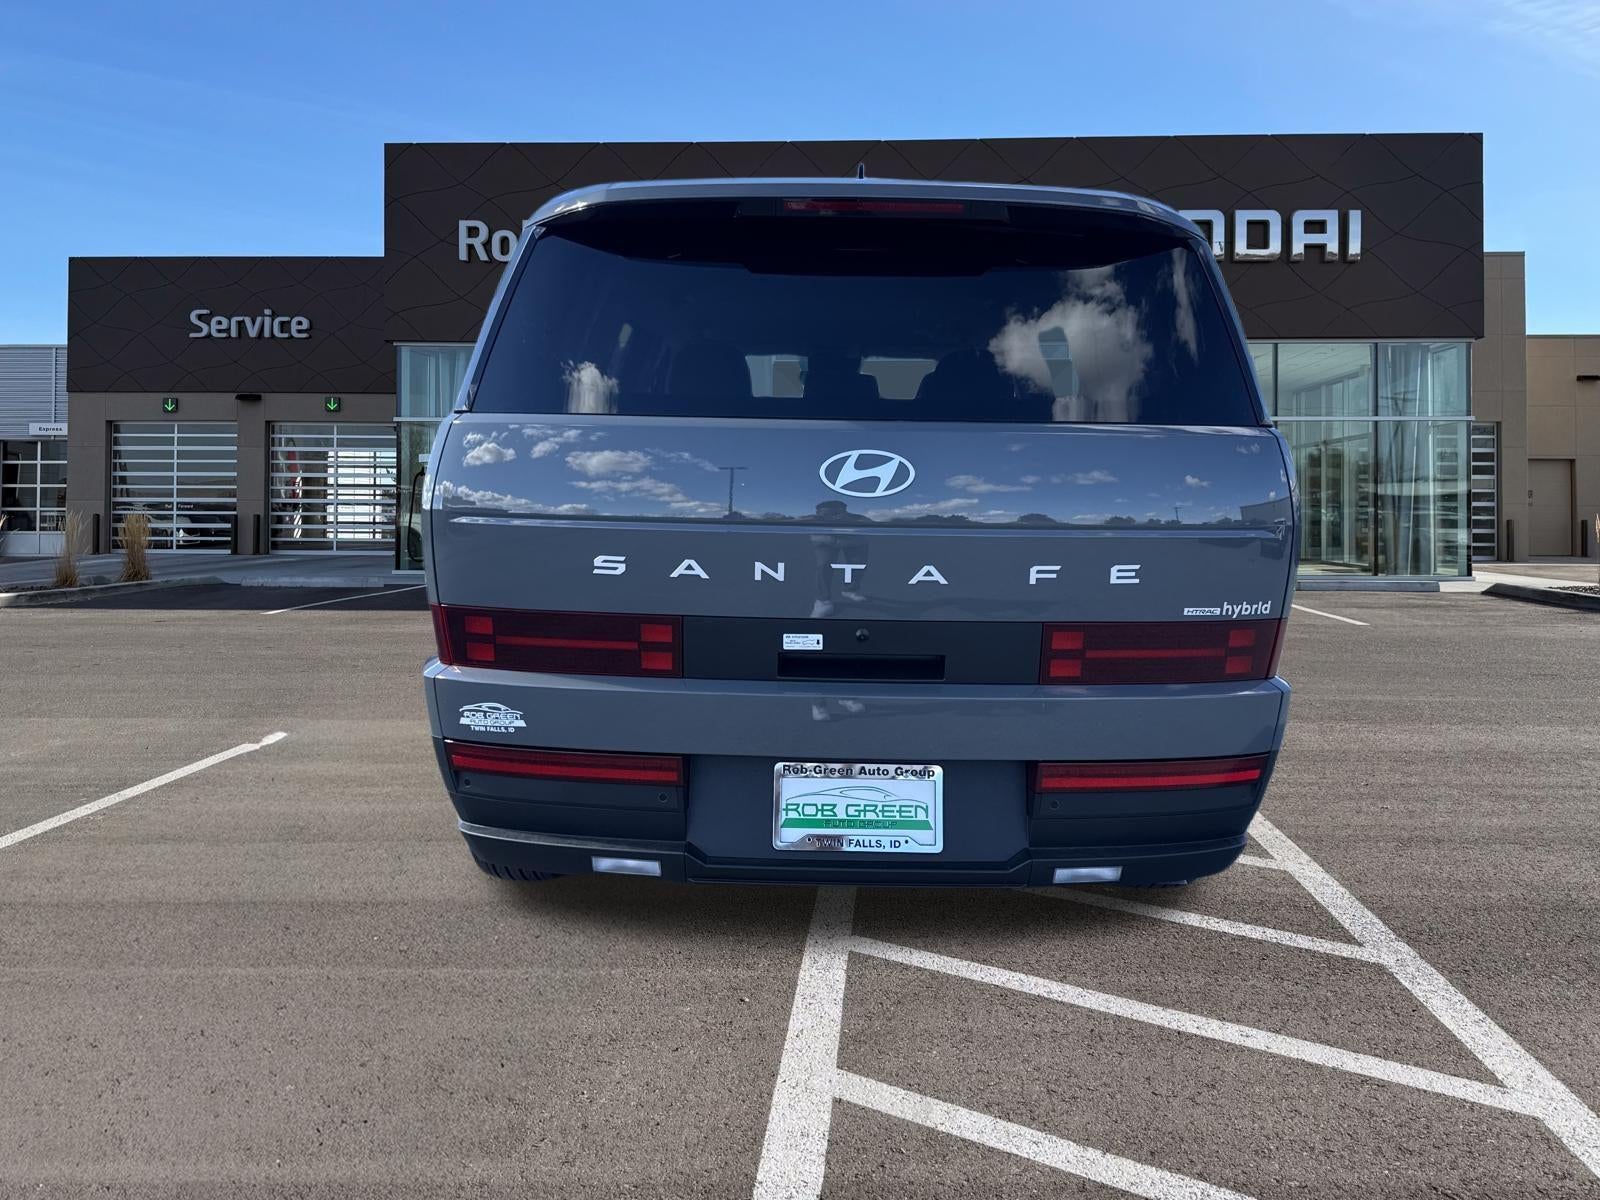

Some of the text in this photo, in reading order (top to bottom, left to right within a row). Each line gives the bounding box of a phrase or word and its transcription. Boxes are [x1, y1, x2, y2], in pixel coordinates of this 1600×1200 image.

[459, 219, 529, 262] Ro
[189, 308, 310, 338] Service
[593, 555, 1141, 585] SANTA FE
[1222, 601, 1272, 618] hybrid
[858, 766, 889, 777] Auto
[894, 767, 935, 779] Group
[783, 803, 928, 819] ROB GREEN
[815, 838, 901, 849] TWIN FALLS, ID
